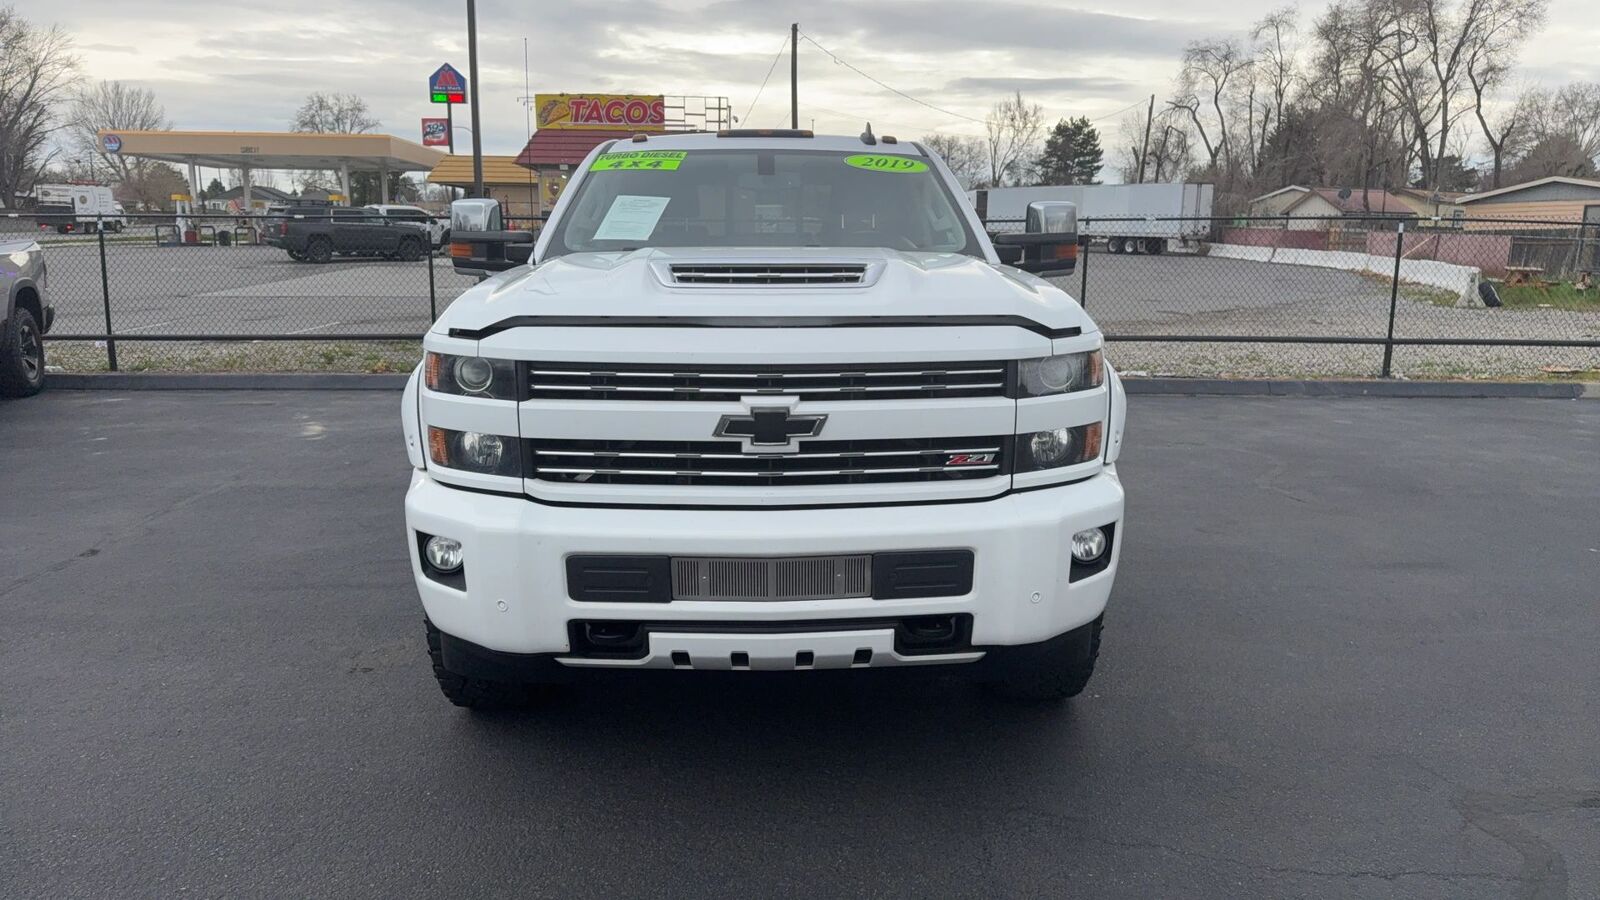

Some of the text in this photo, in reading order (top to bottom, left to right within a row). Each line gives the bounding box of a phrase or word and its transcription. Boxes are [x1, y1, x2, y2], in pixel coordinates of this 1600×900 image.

[569, 98, 664, 125] TACOS
[599, 151, 683, 161] TURBO DIESEL
[861, 157, 915, 169] 2019
[945, 453, 996, 466] Z71
